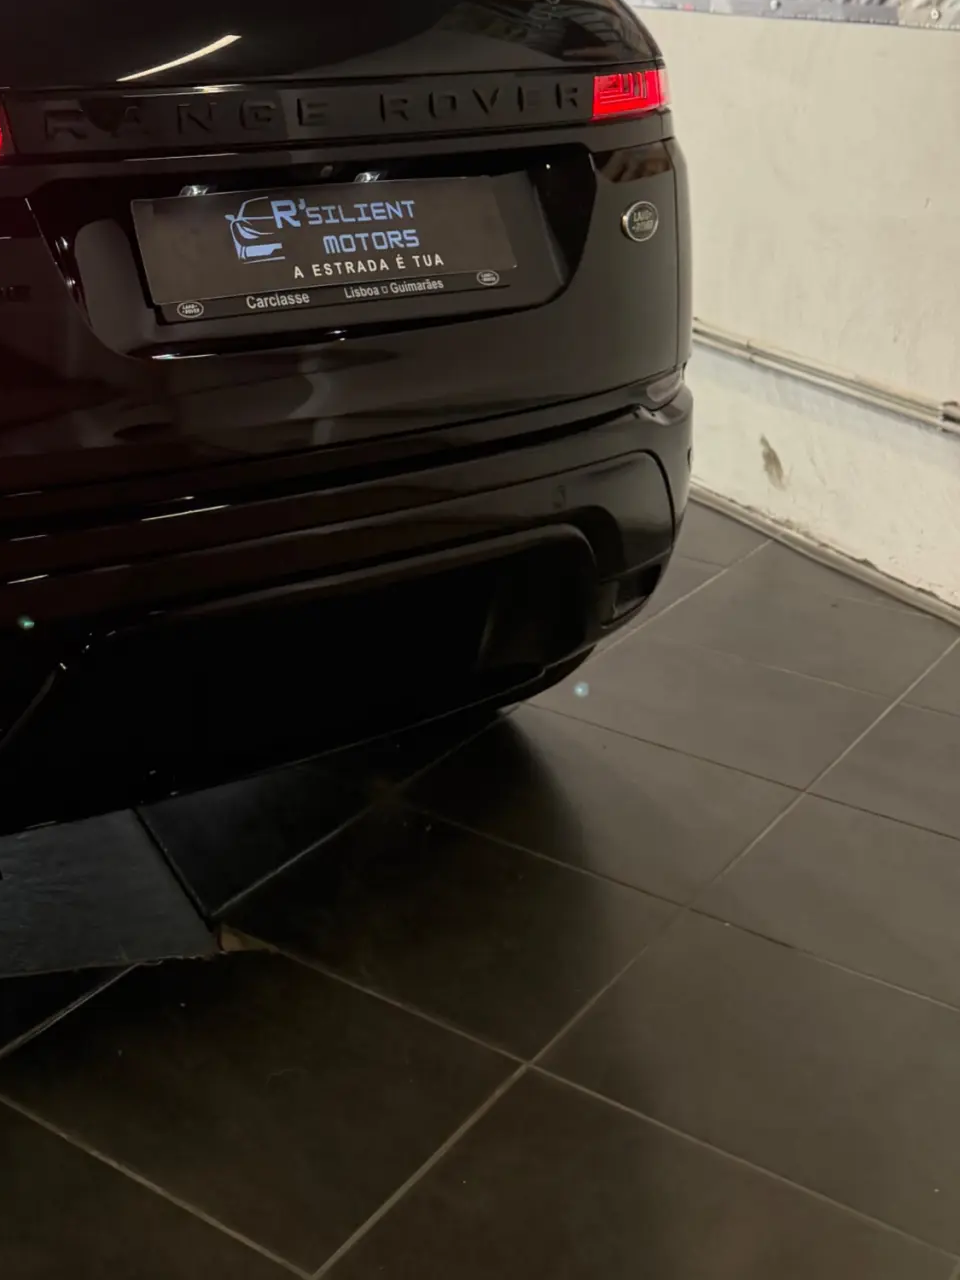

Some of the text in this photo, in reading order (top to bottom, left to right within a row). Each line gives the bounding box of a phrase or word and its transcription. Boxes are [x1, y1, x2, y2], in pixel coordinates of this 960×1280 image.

[44, 81, 580, 140] RANGE ROVER
[270, 198, 415, 229] R'SILIENT
[323, 229, 420, 254] MOTORS
[293, 253, 445, 279] A ESTRADA É TUA
[245, 278, 444, 309] Carclasse Lisboa Guimarães
